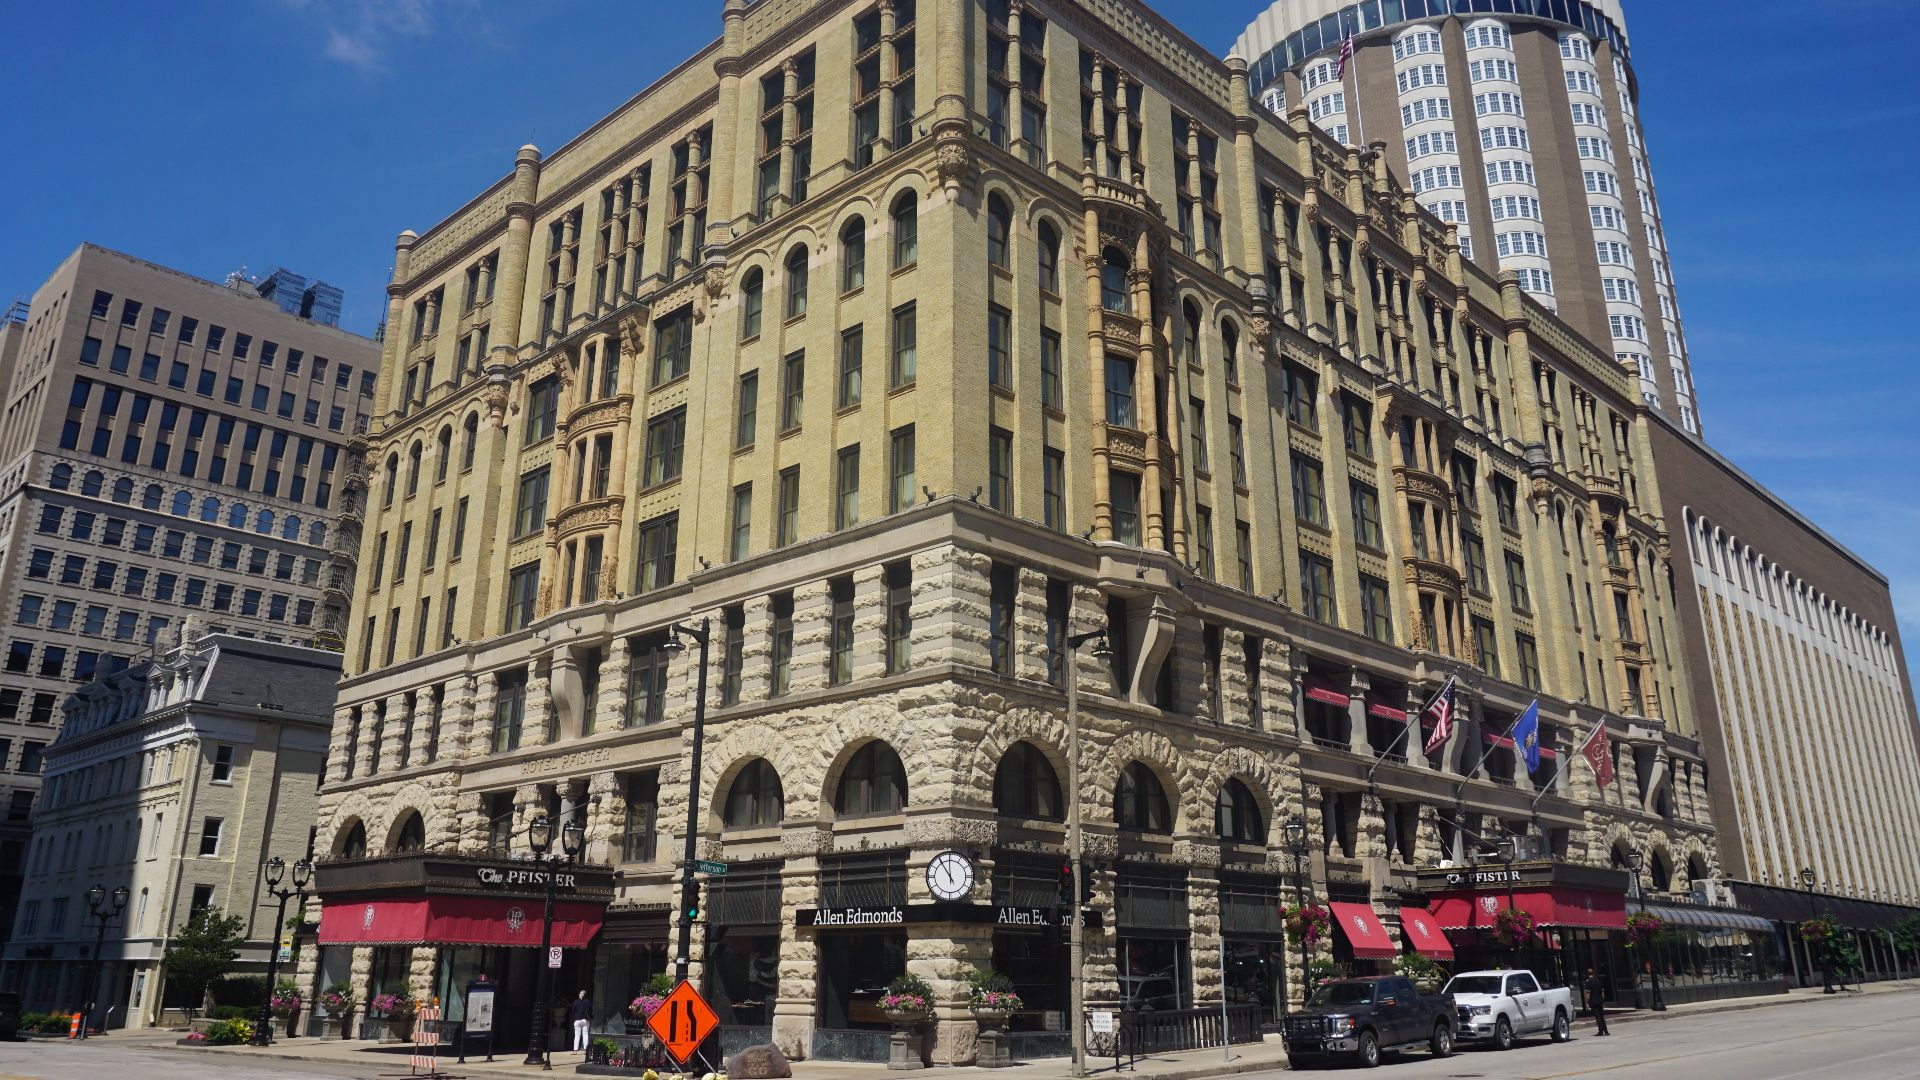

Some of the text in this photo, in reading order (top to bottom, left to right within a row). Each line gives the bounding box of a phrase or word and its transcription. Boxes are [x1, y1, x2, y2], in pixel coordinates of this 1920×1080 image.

[477, 868, 503, 883] The
[812, 906, 903, 925] Allen Edmonds
[998, 907, 1030, 925] Allen
